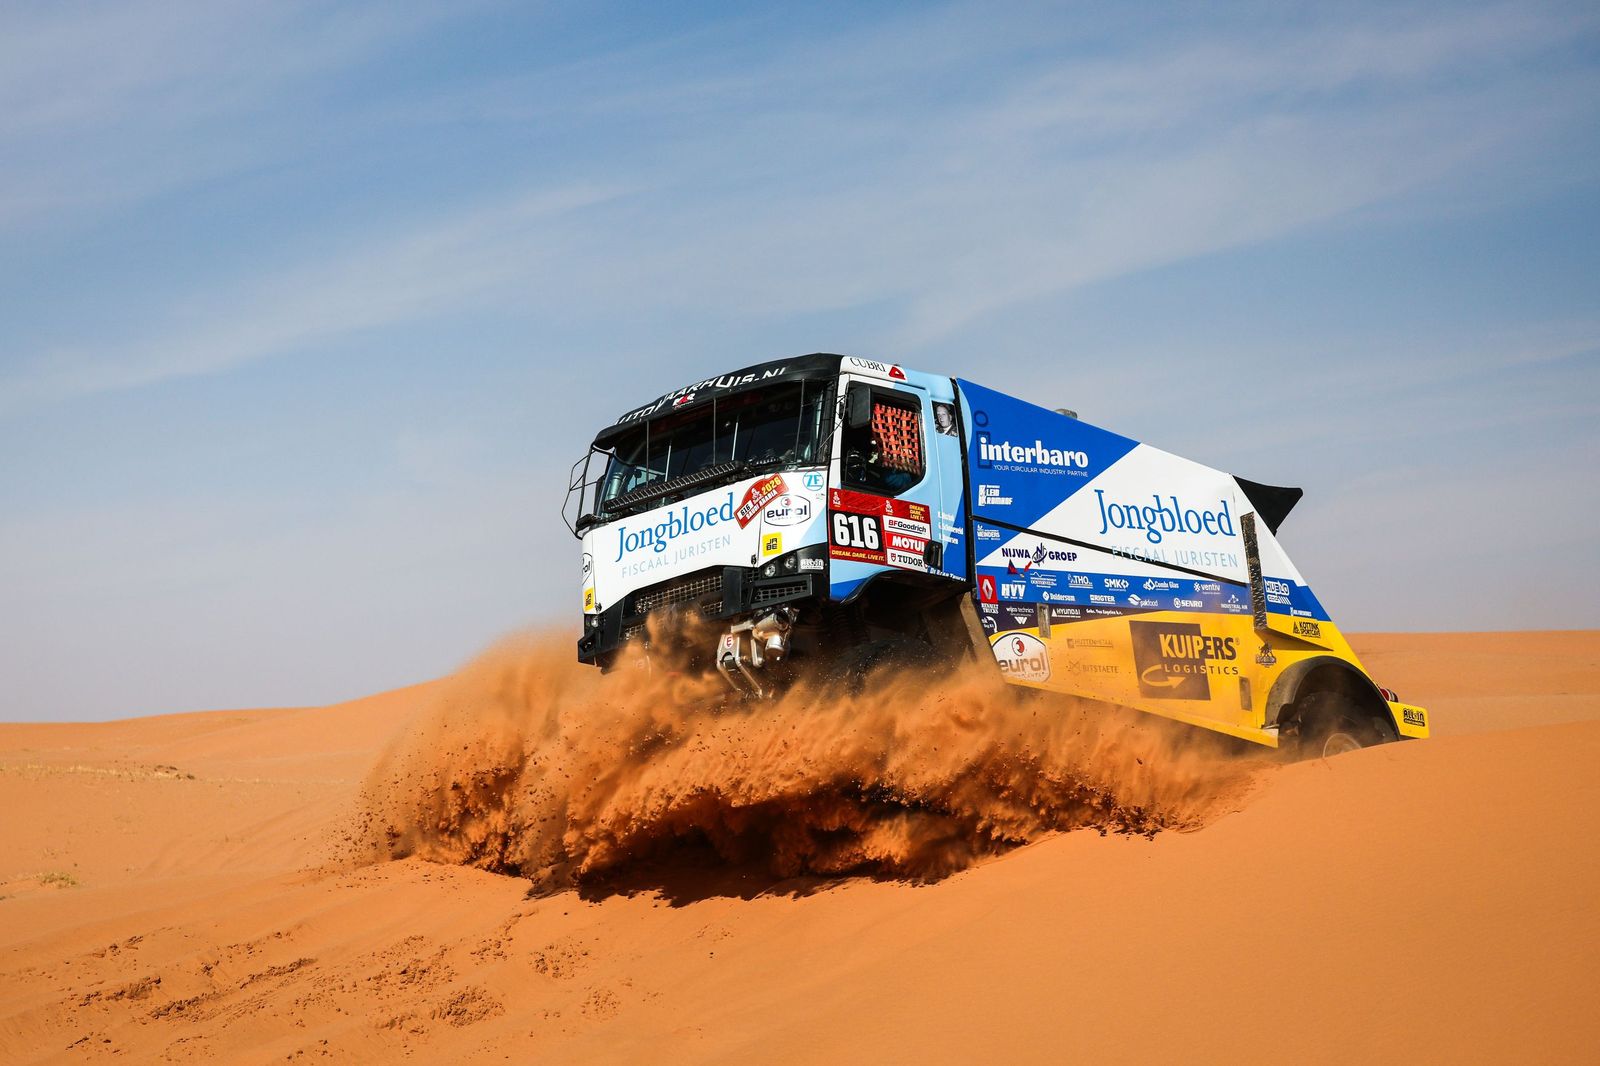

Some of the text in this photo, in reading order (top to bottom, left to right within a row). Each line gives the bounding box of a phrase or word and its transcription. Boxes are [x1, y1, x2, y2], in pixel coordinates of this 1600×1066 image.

[980, 437, 1089, 468] interbaro
[1010, 465, 1038, 473] CIRCULAR
[761, 476, 781, 495] 2026
[806, 474, 822, 487] ZF
[740, 504, 751, 516] 616
[745, 489, 778, 520] SAUDI ARABIA
[766, 505, 807, 518] eurol
[1094, 489, 1236, 544] Jongbloed
[615, 492, 734, 562] Jongbloed
[833, 513, 879, 550] 616
[888, 519, 927, 533] BFGoodrich
[621, 555, 669, 578] FISCAAL
[674, 534, 731, 563] JURISTEN
[831, 549, 851, 558] DREAM.
[1001, 547, 1078, 562] NIJWA GROEP
[1111, 545, 1238, 568] FISCAAL JURISTEN
[897, 555, 923, 567] TUDOR
[1001, 583, 1026, 597] HVV
[1104, 578, 1122, 589] SMK
[1181, 599, 1203, 608] SENRO
[1159, 634, 1237, 660] KUIPERS
[998, 652, 1047, 673] eurol
[1163, 664, 1239, 675] LOGISTICS
